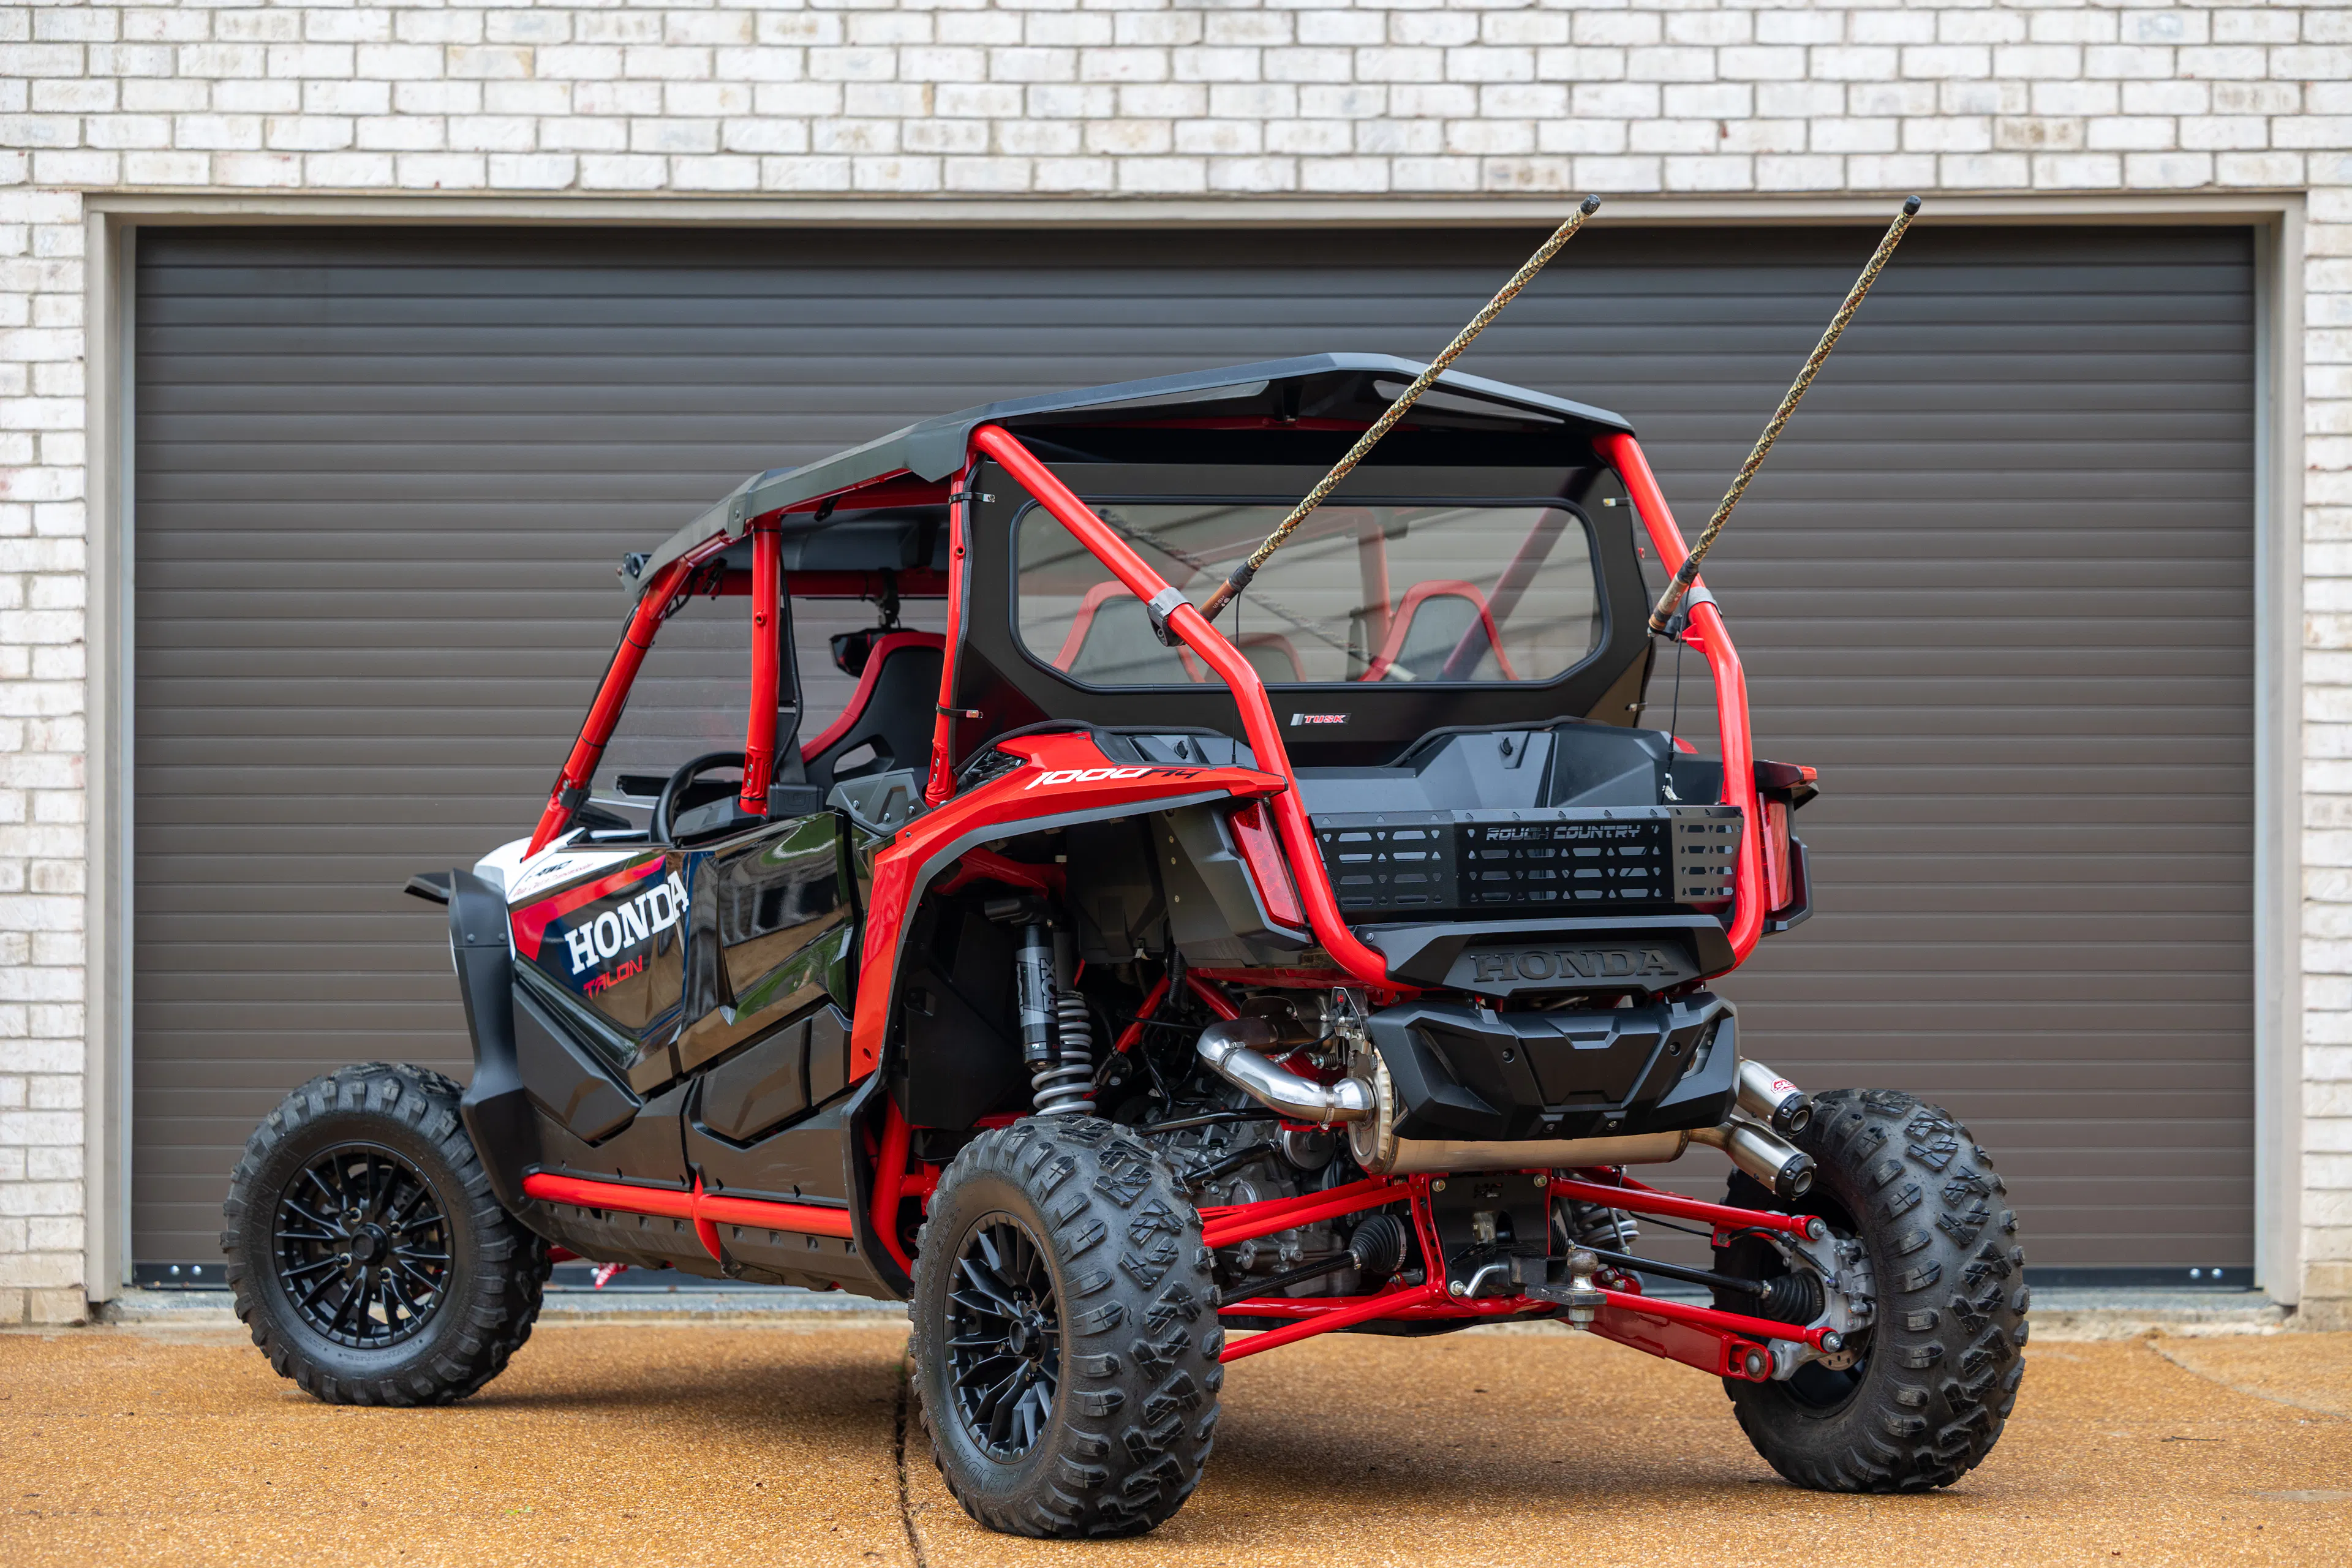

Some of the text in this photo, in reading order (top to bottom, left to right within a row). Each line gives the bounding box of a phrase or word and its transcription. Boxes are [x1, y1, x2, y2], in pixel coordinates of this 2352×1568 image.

[1304, 715, 1346, 723] TUSK
[1486, 825, 1641, 841] ROUGH COUNTRY
[564, 870, 689, 976] HONDA
[583, 955, 643, 1000] TALON
[1470, 949, 1679, 982] HONDA
[1040, 959, 1057, 1012] FOX
